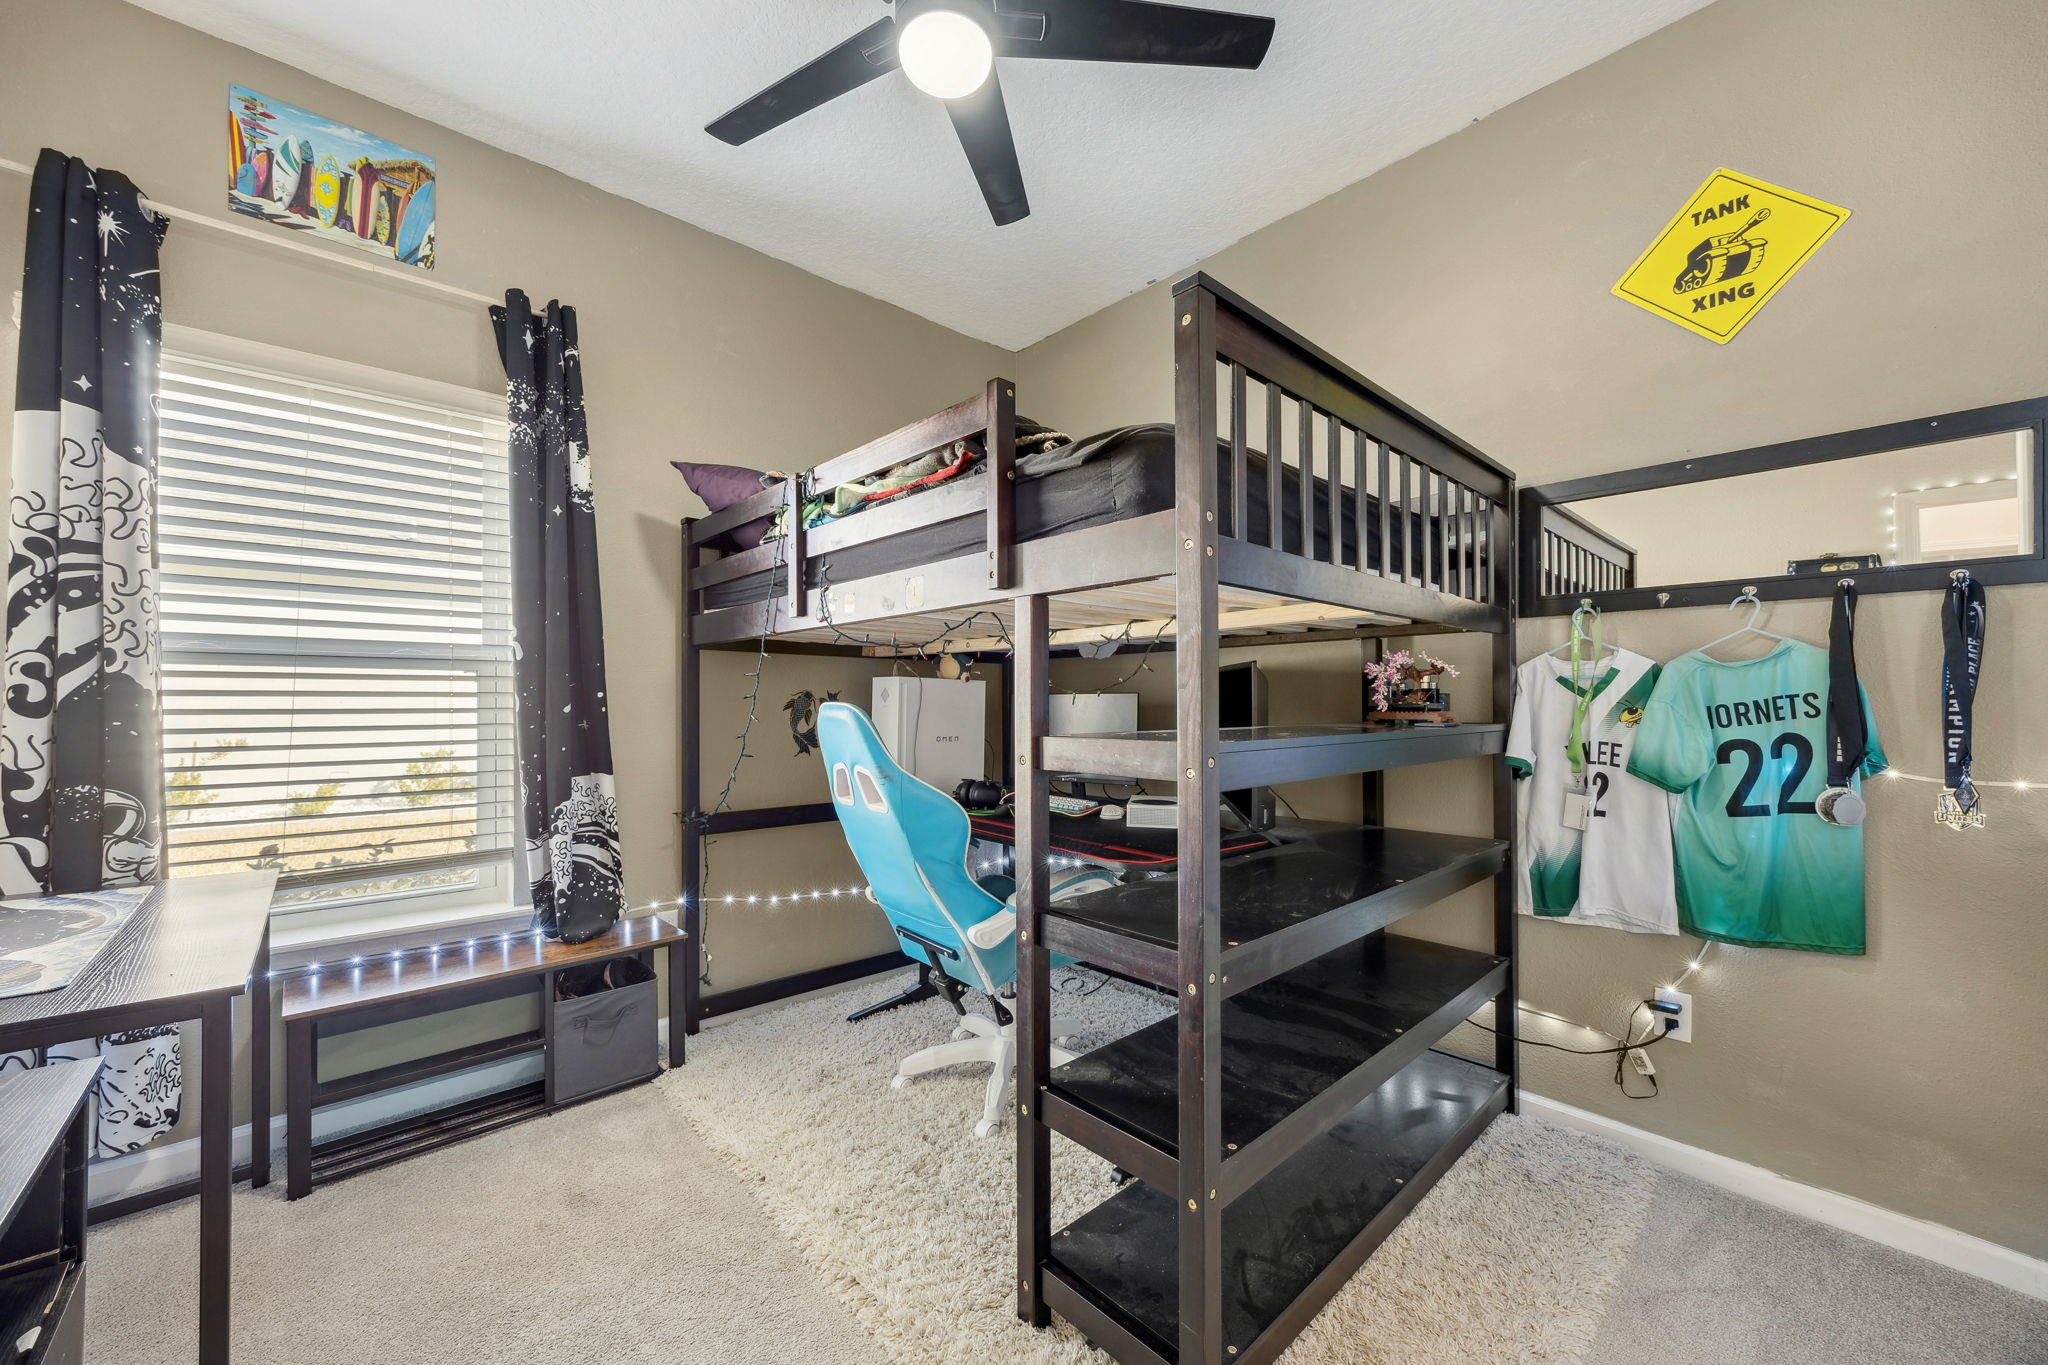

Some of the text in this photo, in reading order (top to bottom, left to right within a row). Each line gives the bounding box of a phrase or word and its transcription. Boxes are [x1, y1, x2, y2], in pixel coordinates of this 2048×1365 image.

[1691, 194, 1750, 227] TANK
[1691, 282, 1755, 313] XING
[1716, 732, 1814, 817] 22
